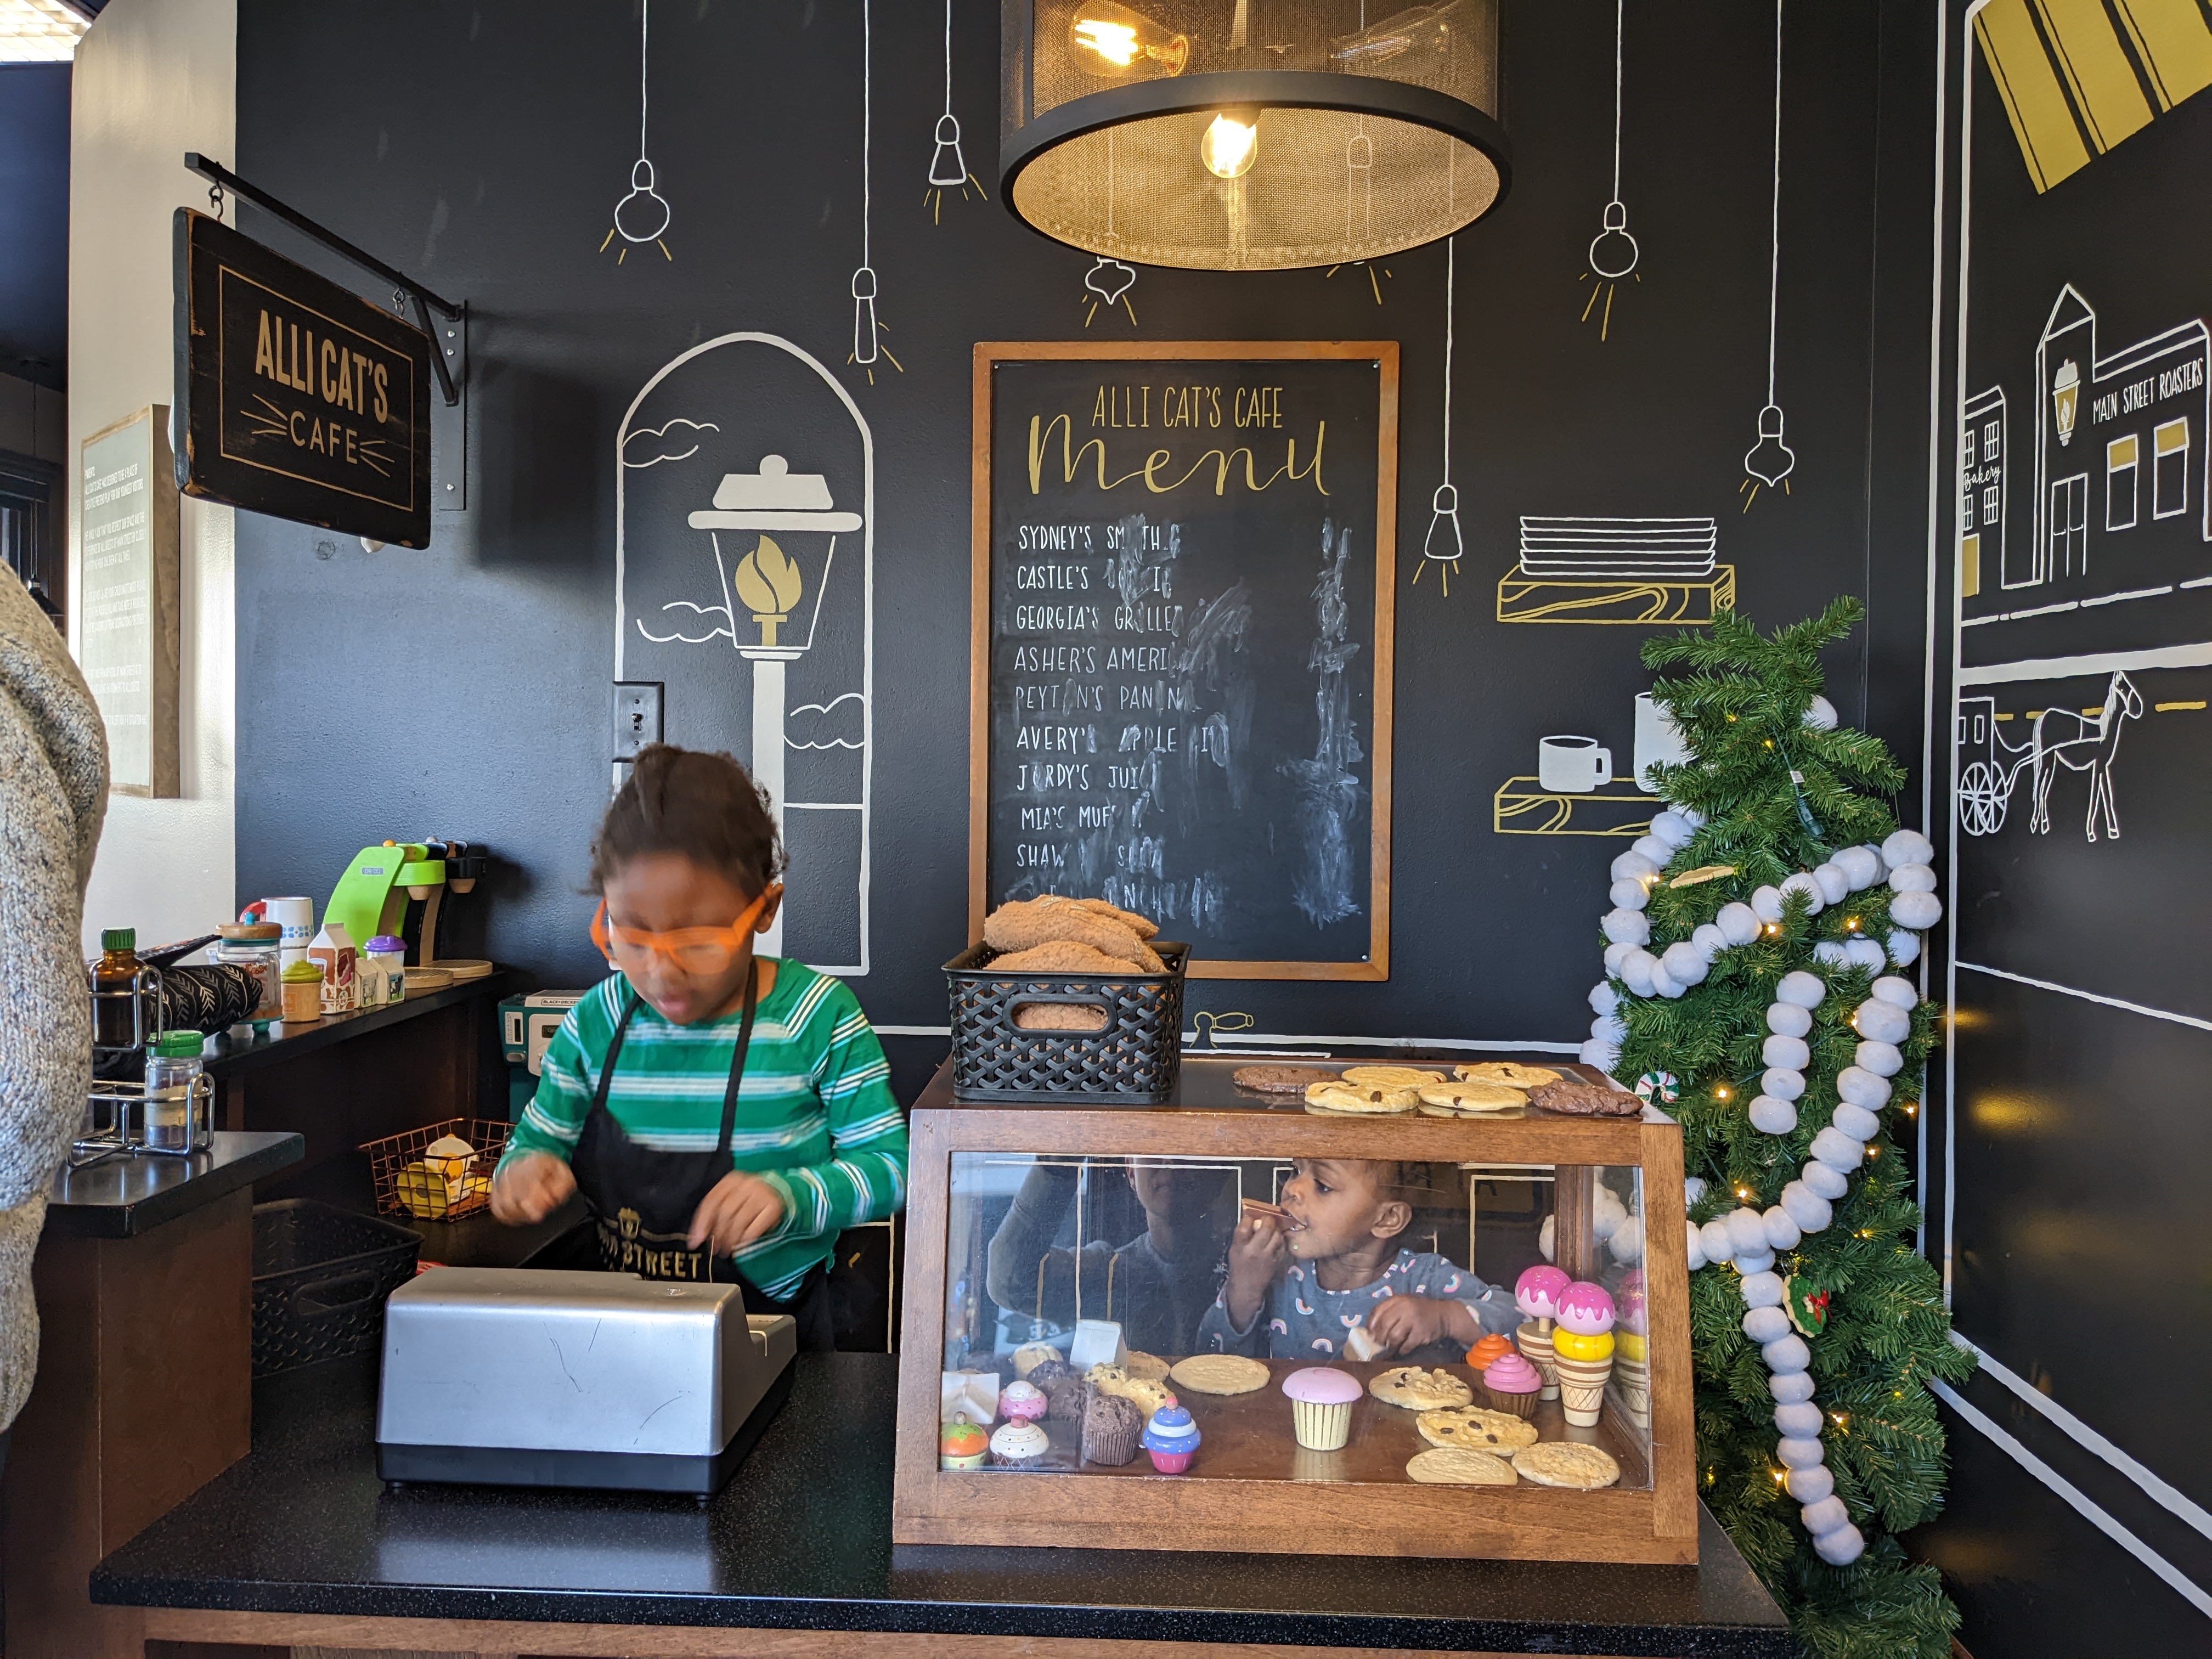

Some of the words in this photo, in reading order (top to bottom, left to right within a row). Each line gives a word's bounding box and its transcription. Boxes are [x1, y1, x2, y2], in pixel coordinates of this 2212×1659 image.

[256, 309, 313, 395] ALLI
[321, 339, 388, 423] CAT'S
[2093, 392, 2117, 425] MAIN
[2123, 377, 2155, 414] STREET
[2159, 358, 2204, 401] ROASTERS
[1092, 385, 1149, 427] ALLI
[1164, 387, 1221, 428] CAT'S
[1235, 387, 1283, 428] CAFE
[290, 411, 357, 464] CAFE
[1963, 465, 2001, 492] Bakery
[1019, 525, 1092, 550] SYDNEY'S
[1017, 566, 1088, 590] CASTLE'S
[1017, 605, 1099, 630] GEORGIA'S
[1014, 646, 1096, 673] ASHER'S
[1015, 684, 1103, 714] PEYTN'S
[1022, 806, 1065, 830] MIA'S
[622, 1241, 702, 1279] STREET
